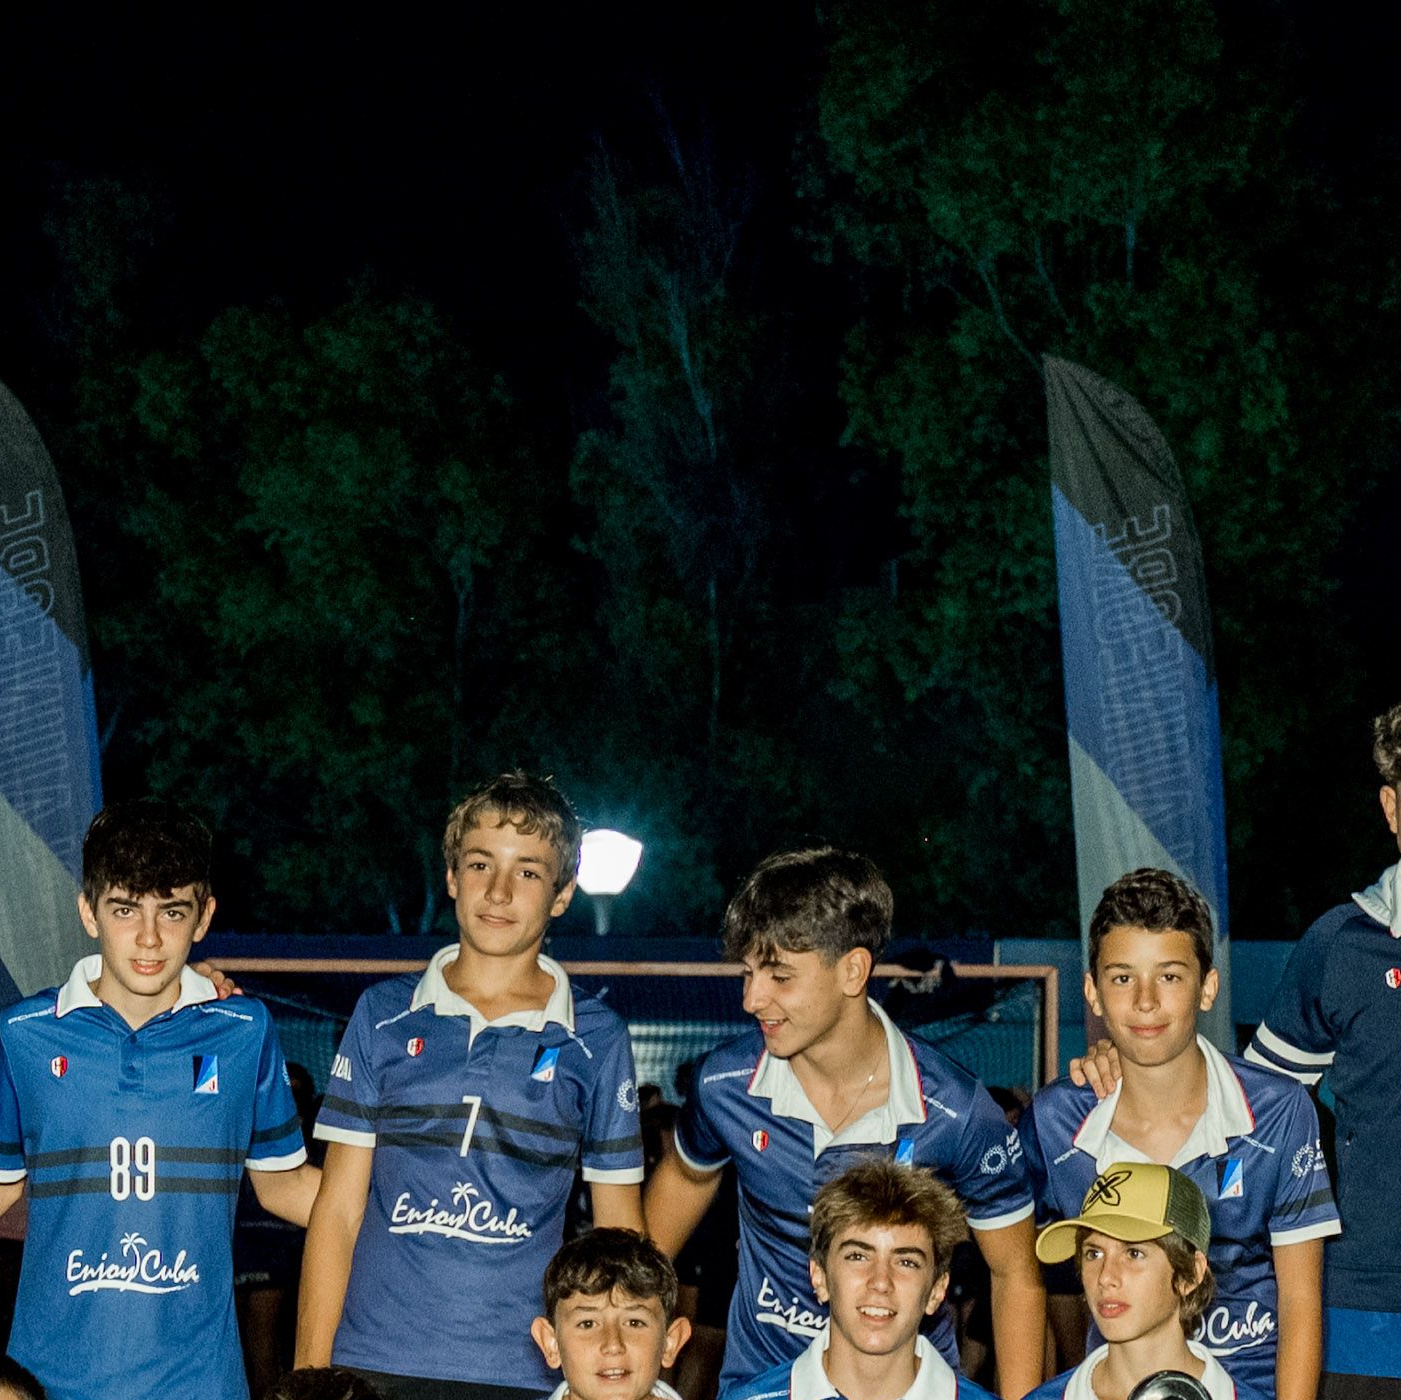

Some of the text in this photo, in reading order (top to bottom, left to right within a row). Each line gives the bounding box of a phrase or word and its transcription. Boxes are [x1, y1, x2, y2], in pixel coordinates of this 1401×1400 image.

[462, 1095, 482, 1157] 7
[109, 1136, 156, 1202] 89
[392, 1192, 533, 1238] Enjoy Cuba
[67, 1249, 199, 1284] Enjoy Cuba
[1206, 1301, 1276, 1346] Cuba
